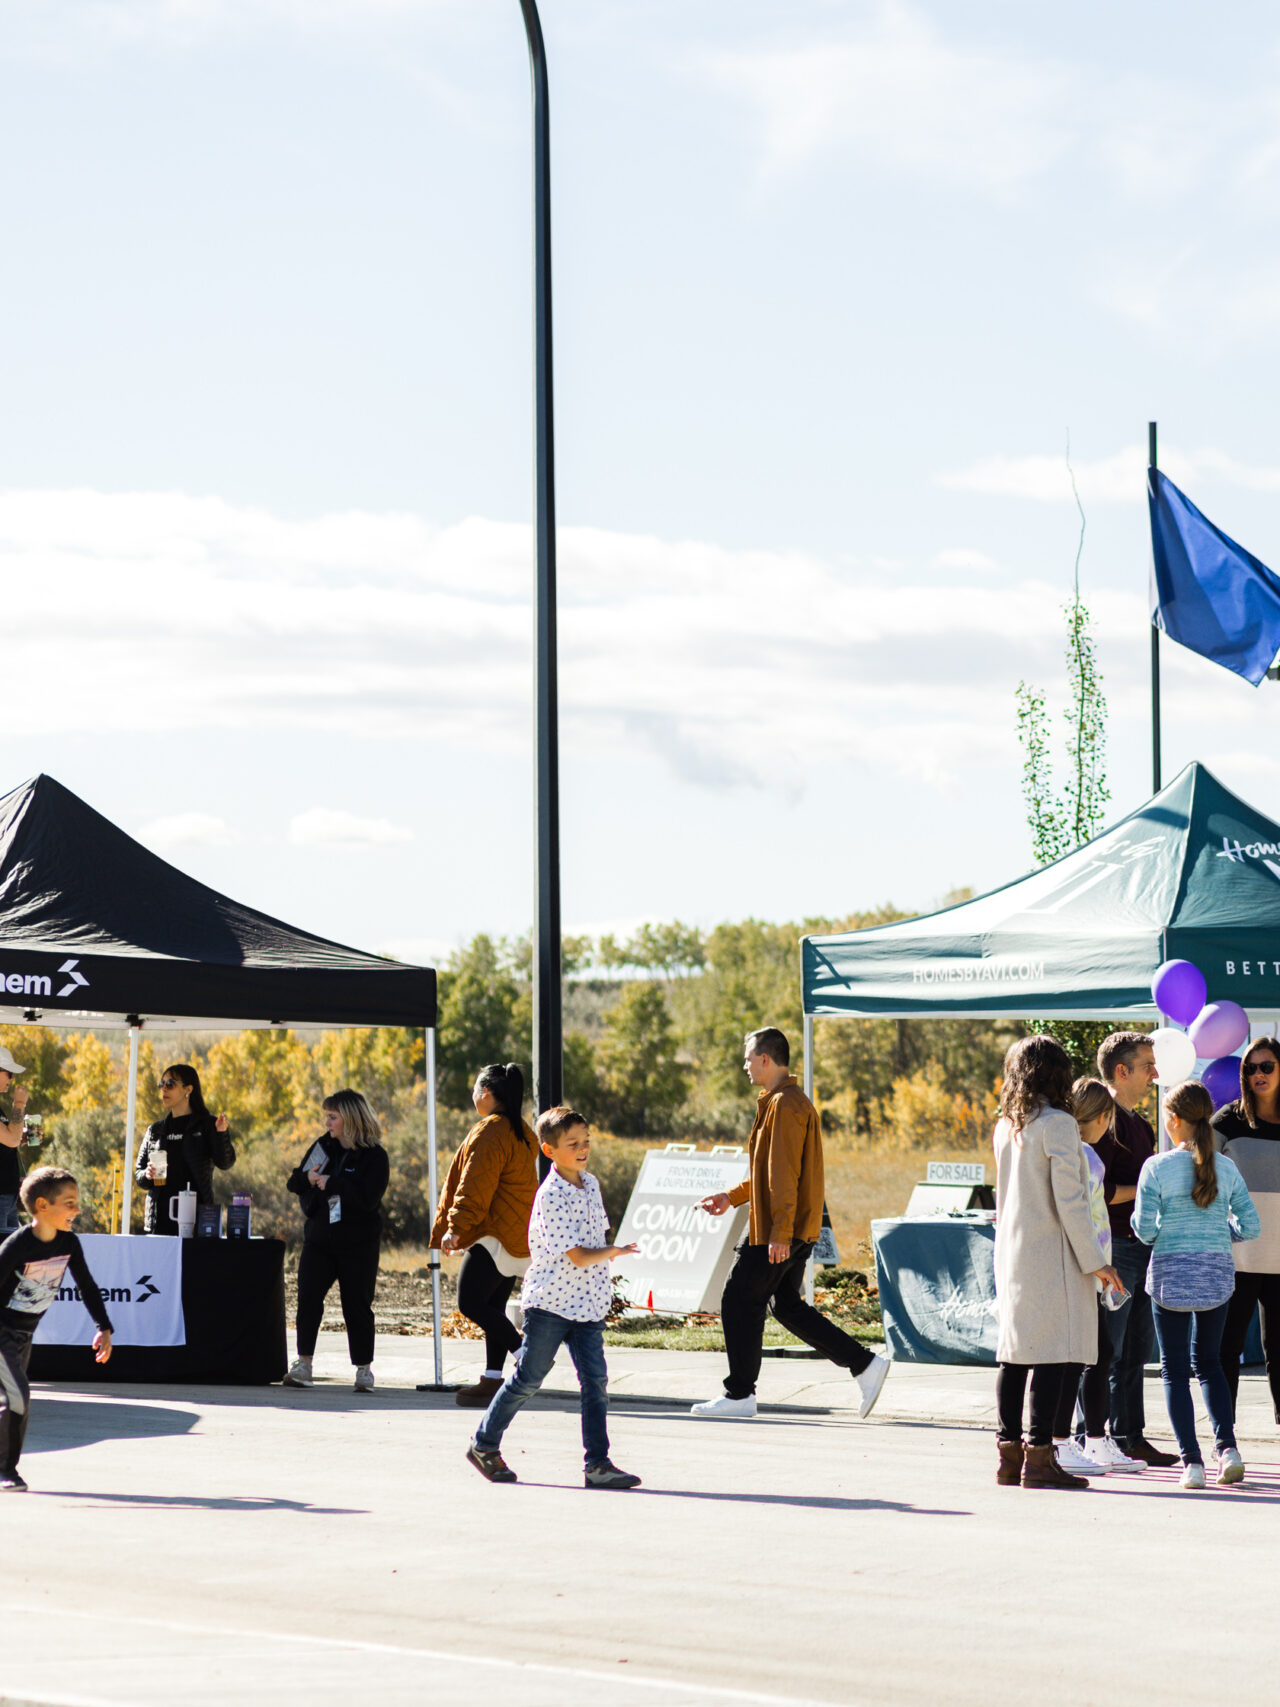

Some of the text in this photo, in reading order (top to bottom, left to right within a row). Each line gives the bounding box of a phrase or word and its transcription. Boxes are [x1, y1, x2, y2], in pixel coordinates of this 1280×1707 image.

[912, 961, 1044, 984] HOMESBYAVI.COM
[667, 1165, 723, 1178] FRONT DRIVE
[929, 1163, 982, 1181] FOR SALE
[663, 1177, 694, 1188] DUPLEX
[695, 1179, 727, 1190] HOMES
[632, 1203, 723, 1234] COMING
[633, 1233, 701, 1263] SOON
